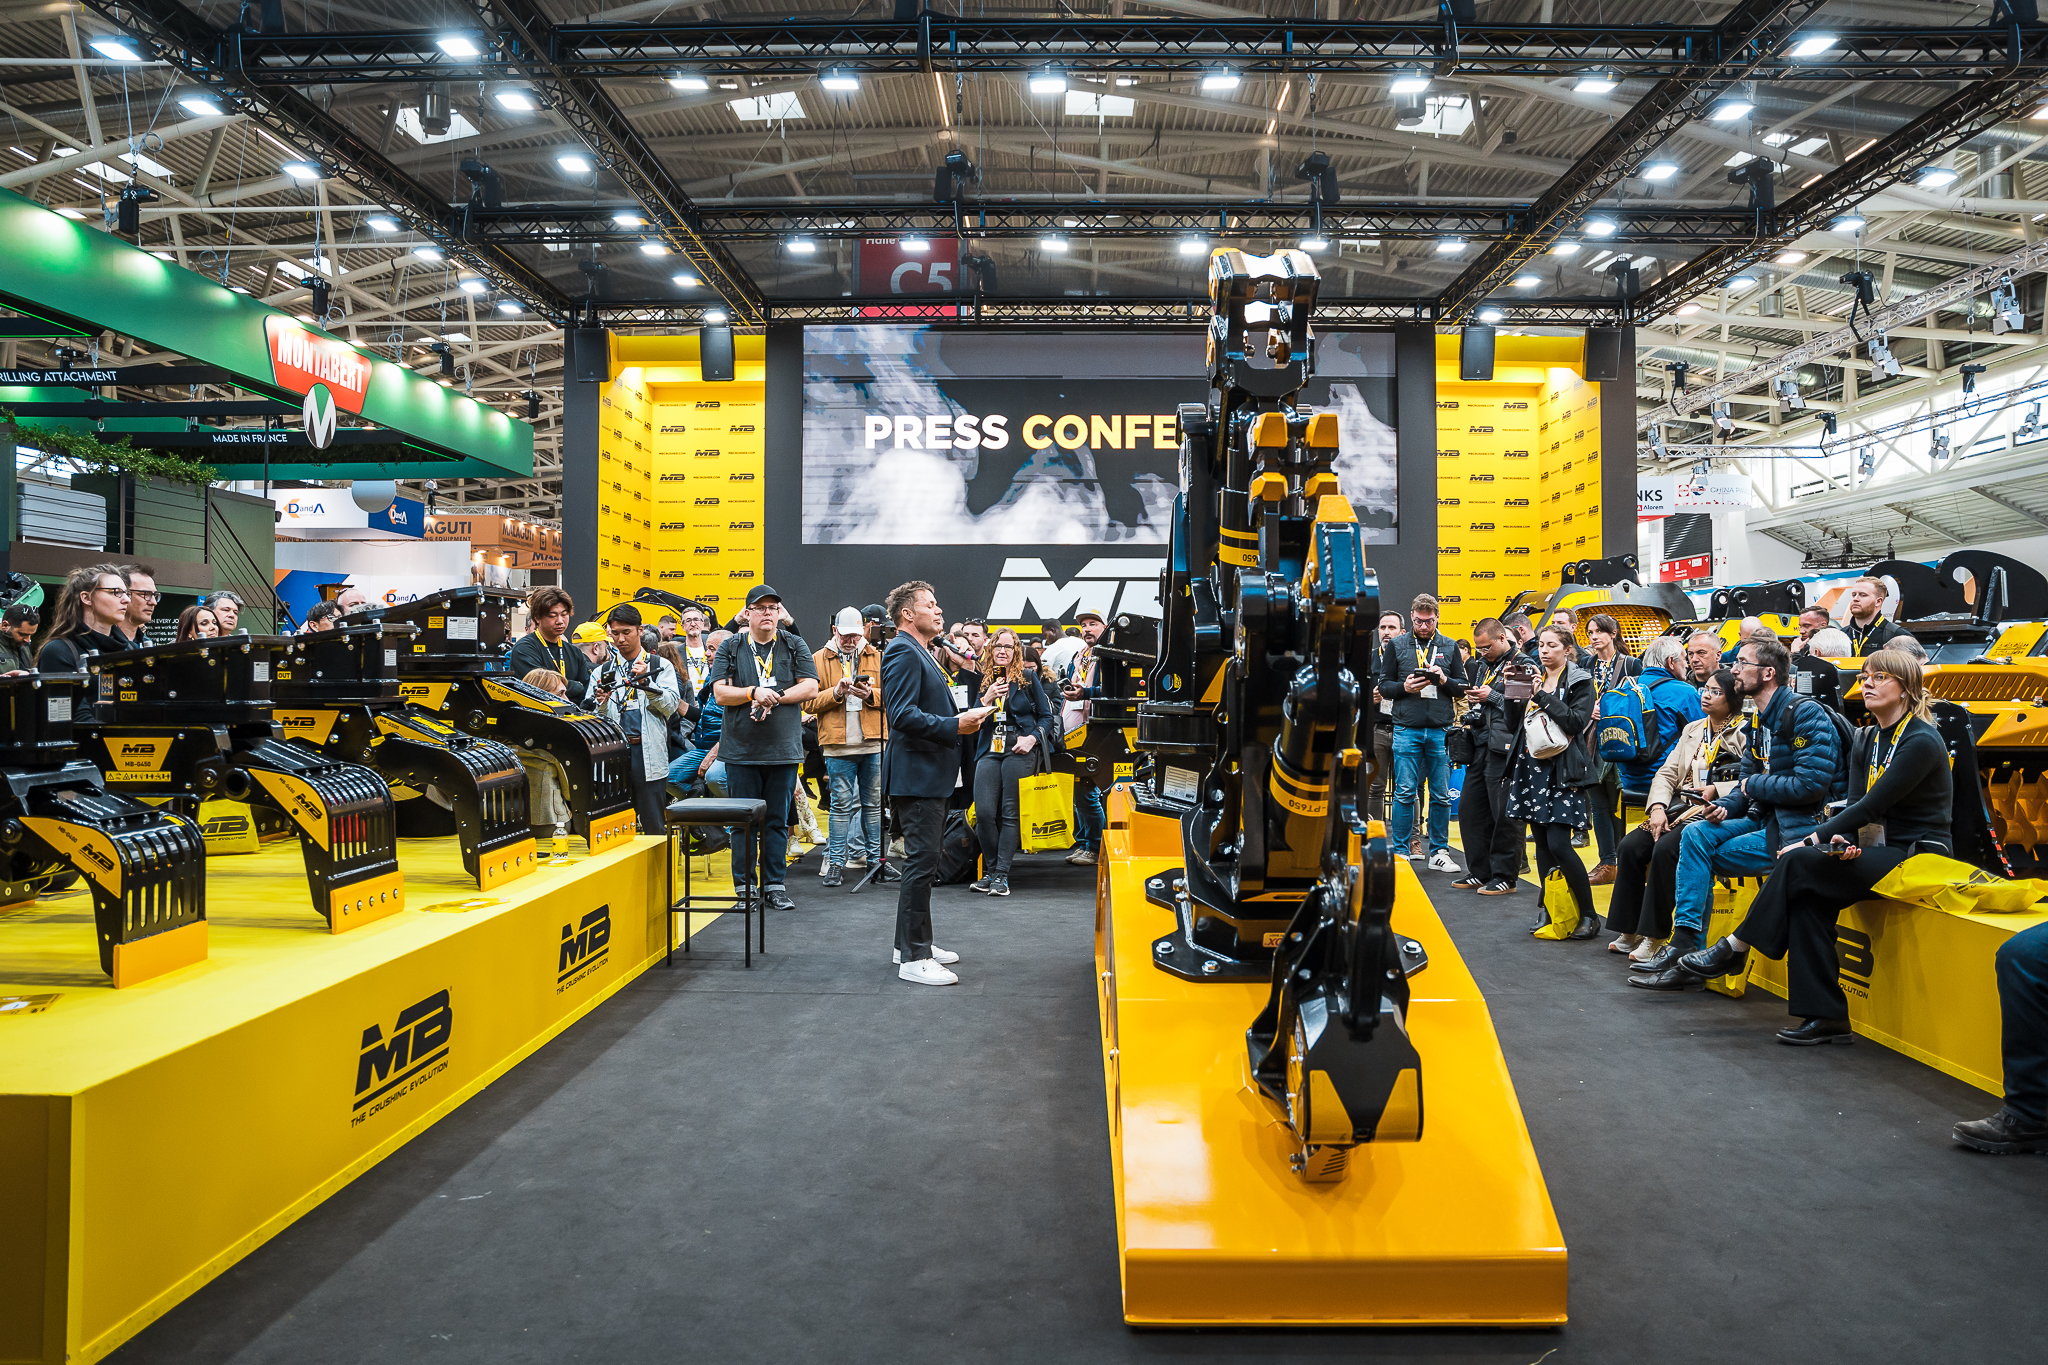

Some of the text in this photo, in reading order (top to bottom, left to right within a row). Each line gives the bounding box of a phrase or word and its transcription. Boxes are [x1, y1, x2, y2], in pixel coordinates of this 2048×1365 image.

[890, 262, 953, 294] C5
[277, 329, 364, 394] MONTABERT
[44, 370, 117, 382] ATTACHMENT
[695, 401, 721, 409] MB
[212, 433, 238, 443] MADE
[240, 433, 250, 442] IN
[864, 414, 1180, 450] PRESS CONFE
[1470, 474, 1495, 482] MB
[424, 521, 472, 535] AGUTI
[503, 522, 534, 541] MALAGUTI
[1471, 571, 1496, 579] MB
[695, 595, 720, 603] MB
[401, 686, 430, 695] MB
[282, 717, 315, 726] MB
[121, 744, 156, 753] MB
[296, 793, 323, 820] MB
[1032, 819, 1067, 834] MB
[81, 843, 115, 871] MB
[558, 904, 611, 974] MB
[556, 957, 608, 996] THE CRUSHING EVOLUTION
[354, 988, 453, 1097] MB
[351, 1060, 449, 1128] THE CRUSHING EVOLUTION
